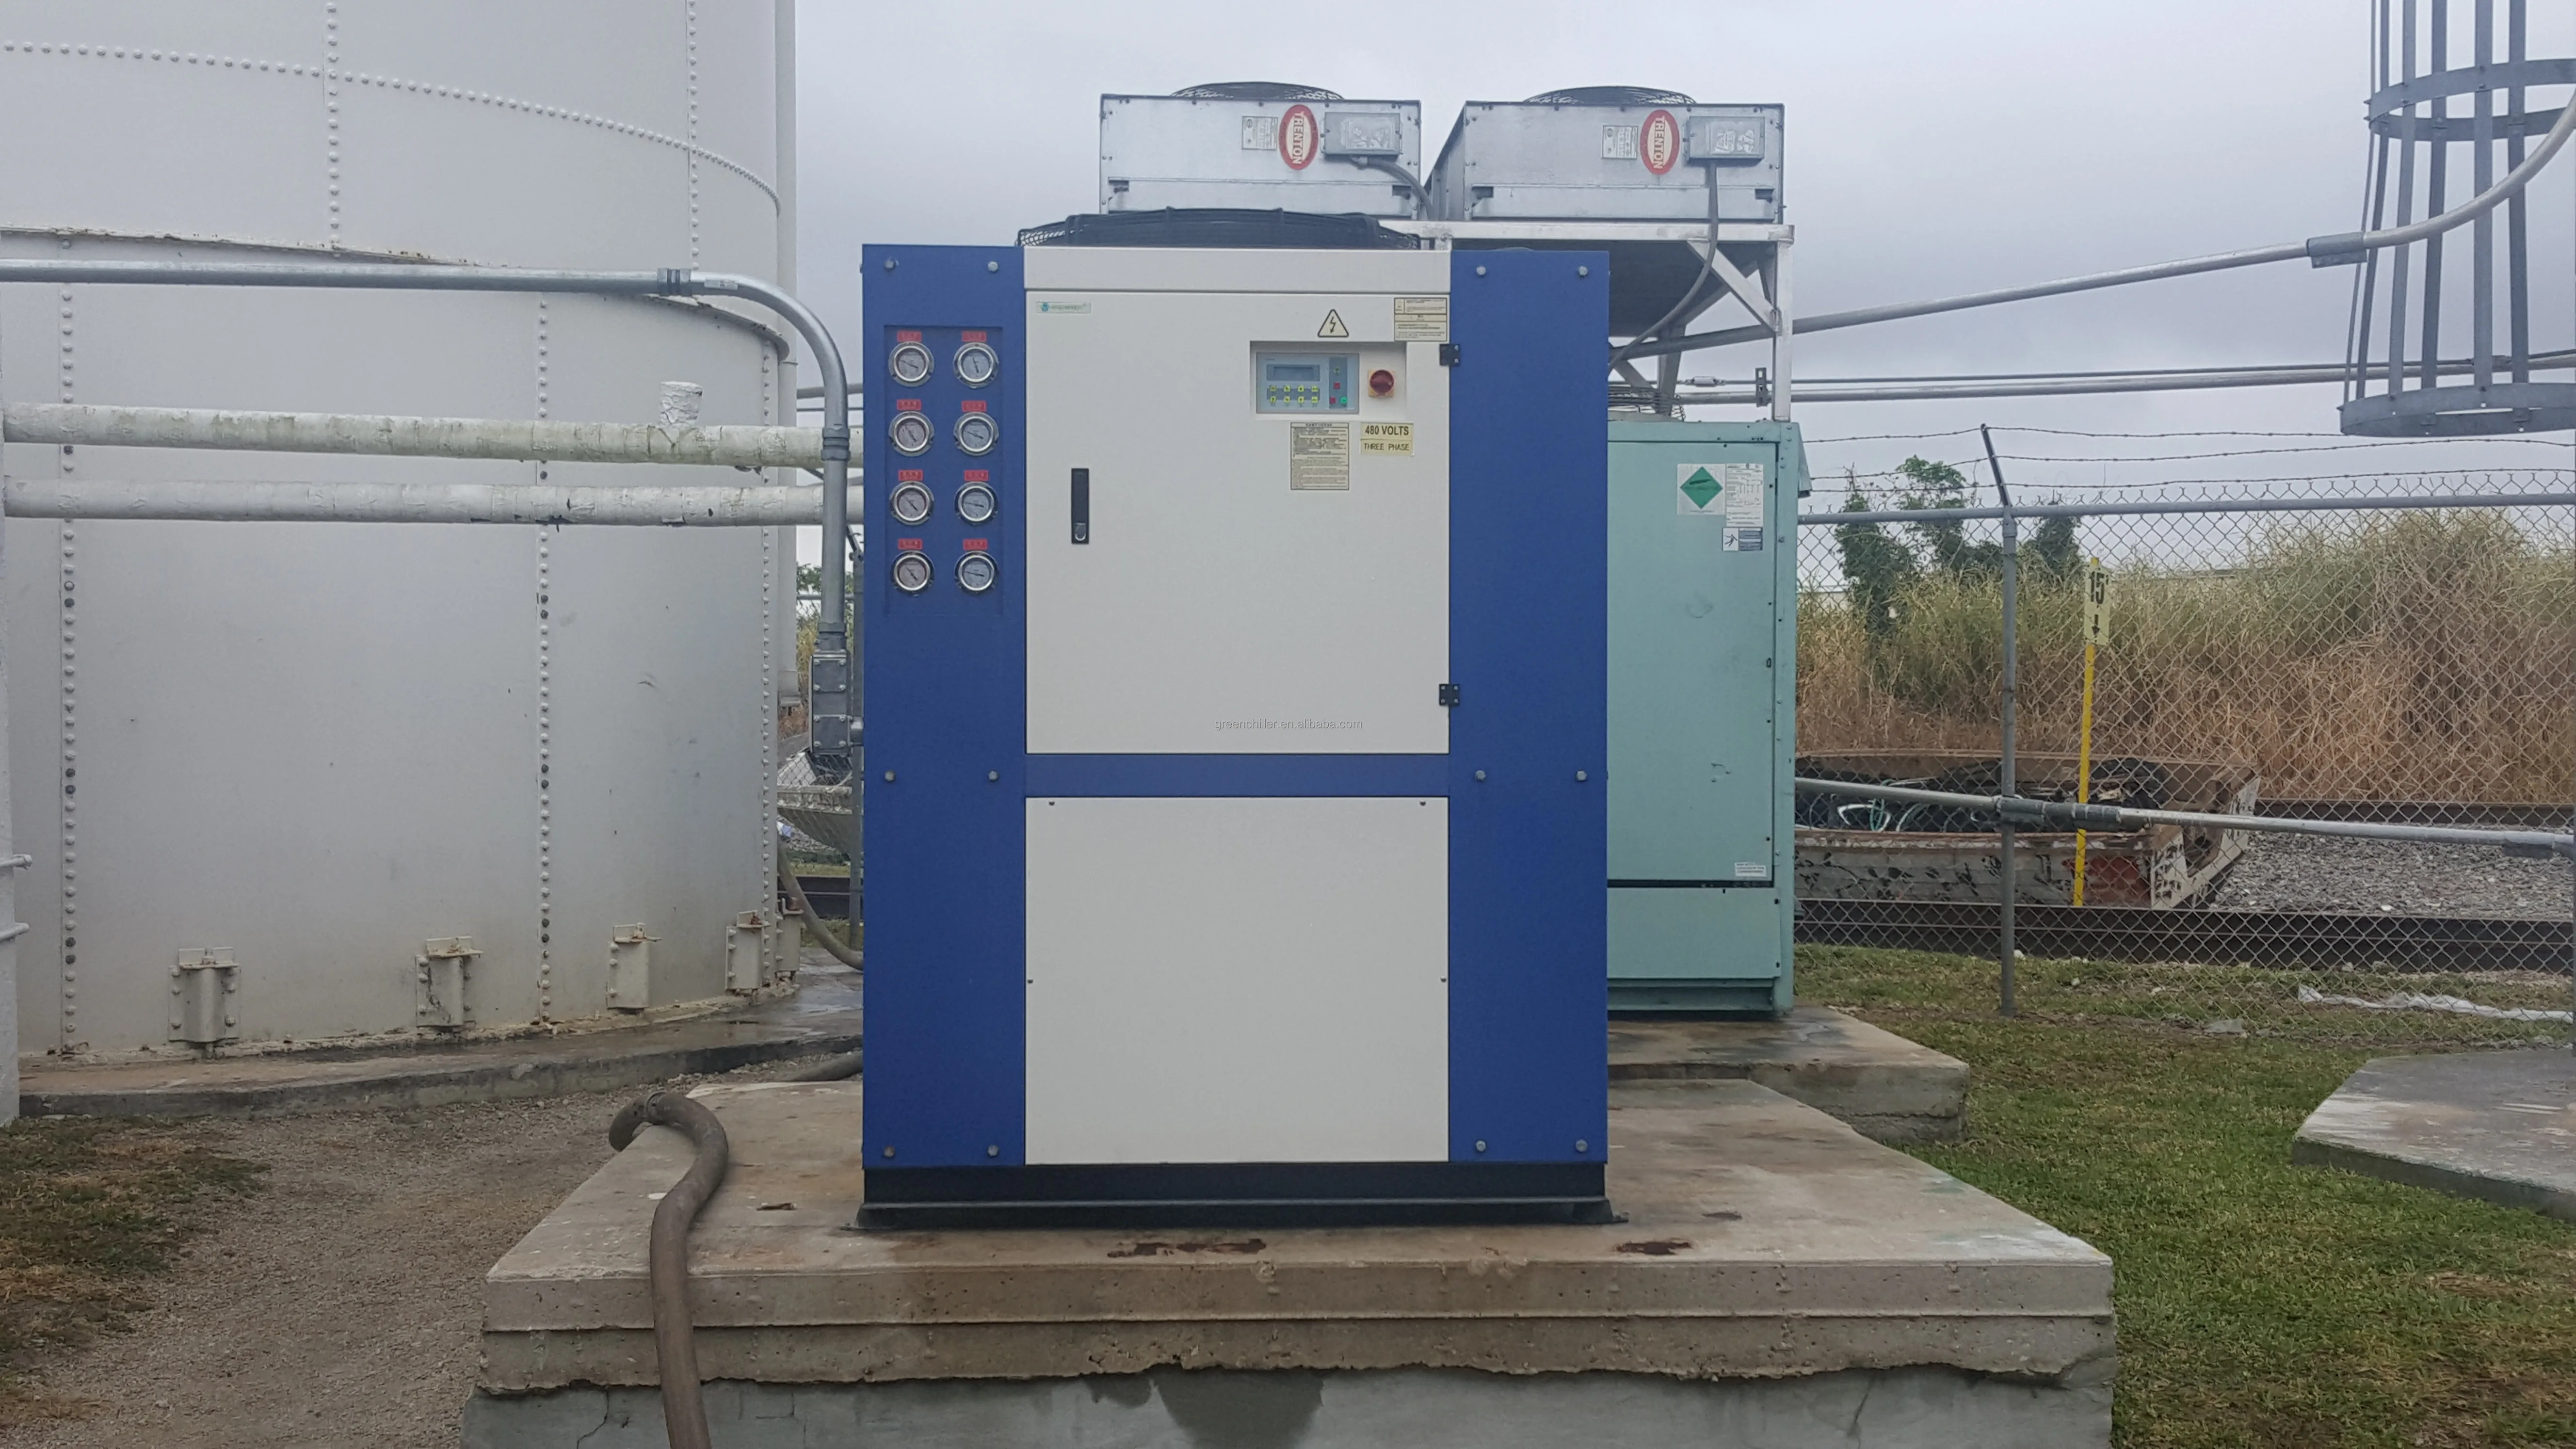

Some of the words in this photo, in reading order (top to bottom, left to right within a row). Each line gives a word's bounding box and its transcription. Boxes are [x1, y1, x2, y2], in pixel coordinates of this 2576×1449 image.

[1292, 111, 1304, 164] TRENTON
[1653, 116, 1665, 169] TRENTON
[1365, 425, 1379, 435] 480
[1382, 426, 1409, 435] VOLTS
